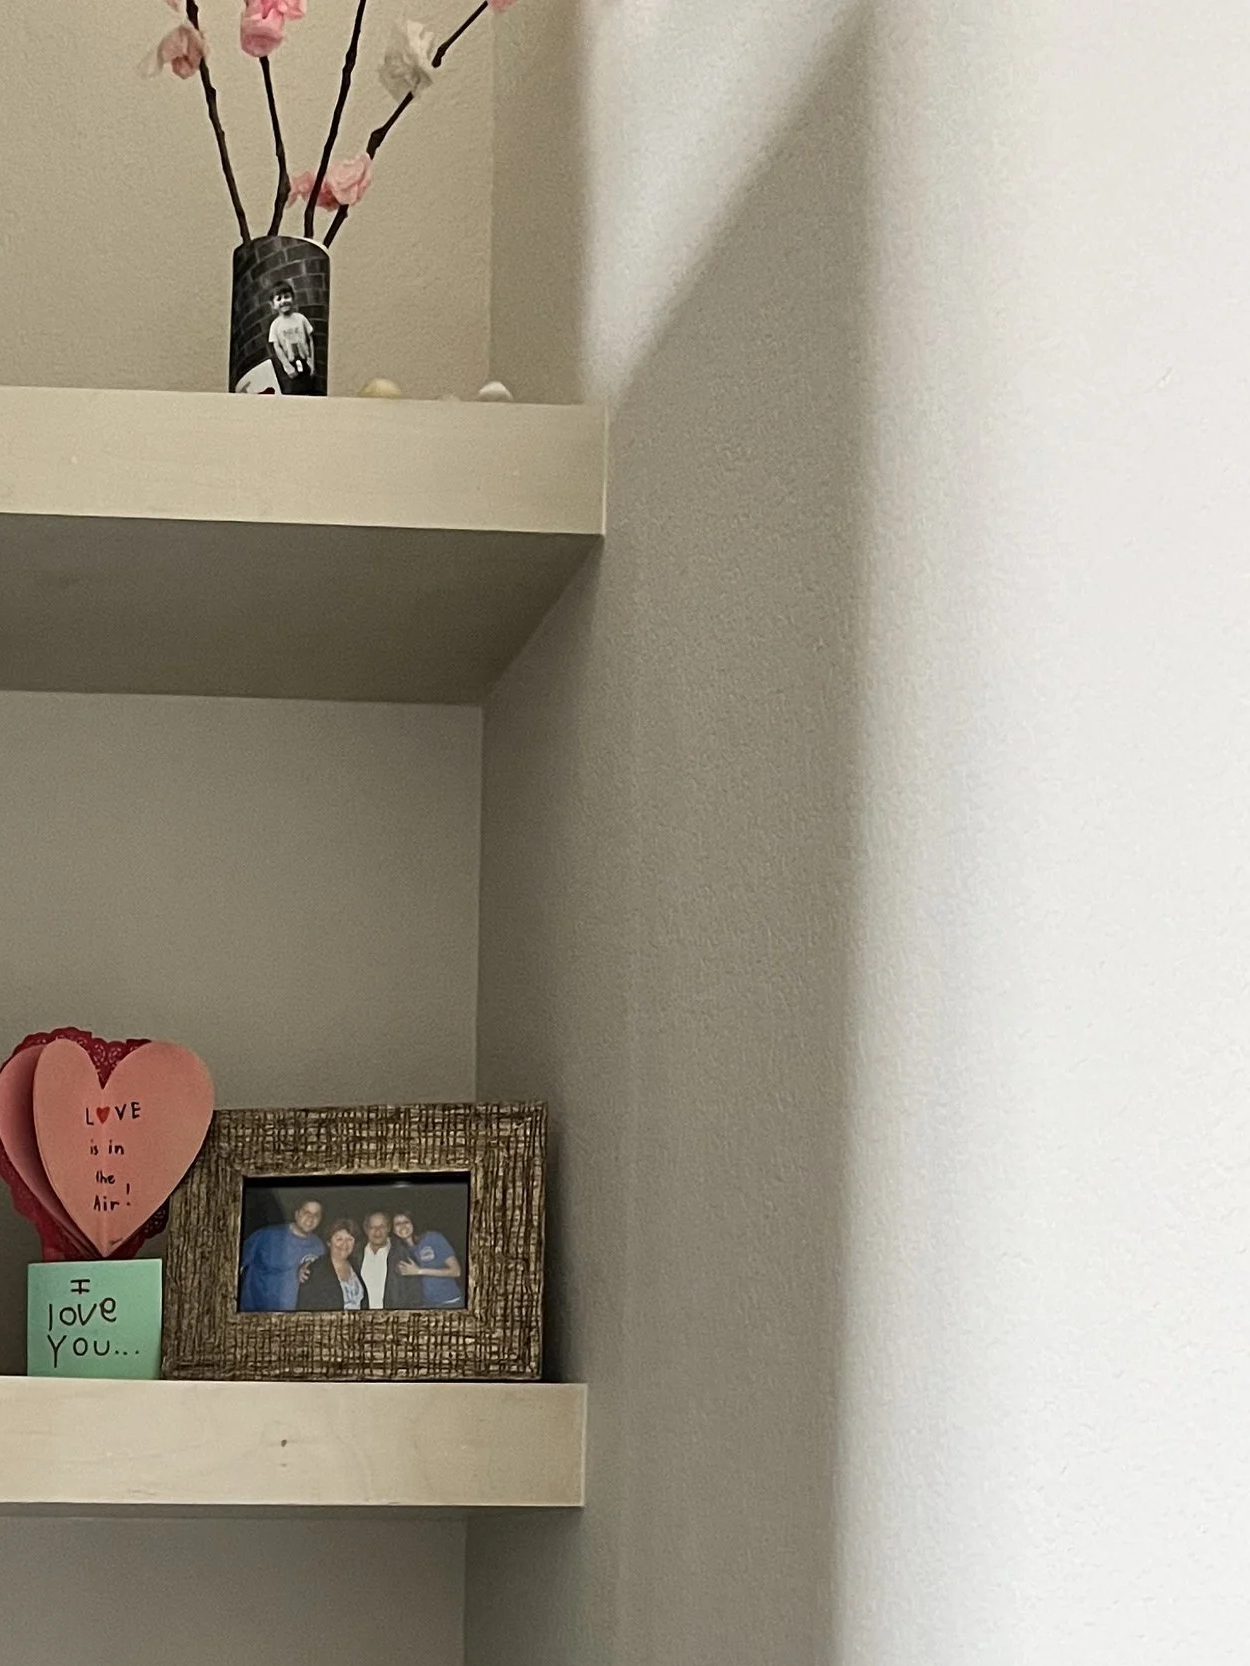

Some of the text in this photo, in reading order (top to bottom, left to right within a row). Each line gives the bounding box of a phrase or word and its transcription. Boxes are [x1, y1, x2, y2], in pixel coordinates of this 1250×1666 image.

[90, 1139, 125, 1155] is in
[70, 1279, 91, 1294] I
[48, 1297, 117, 1332] love
